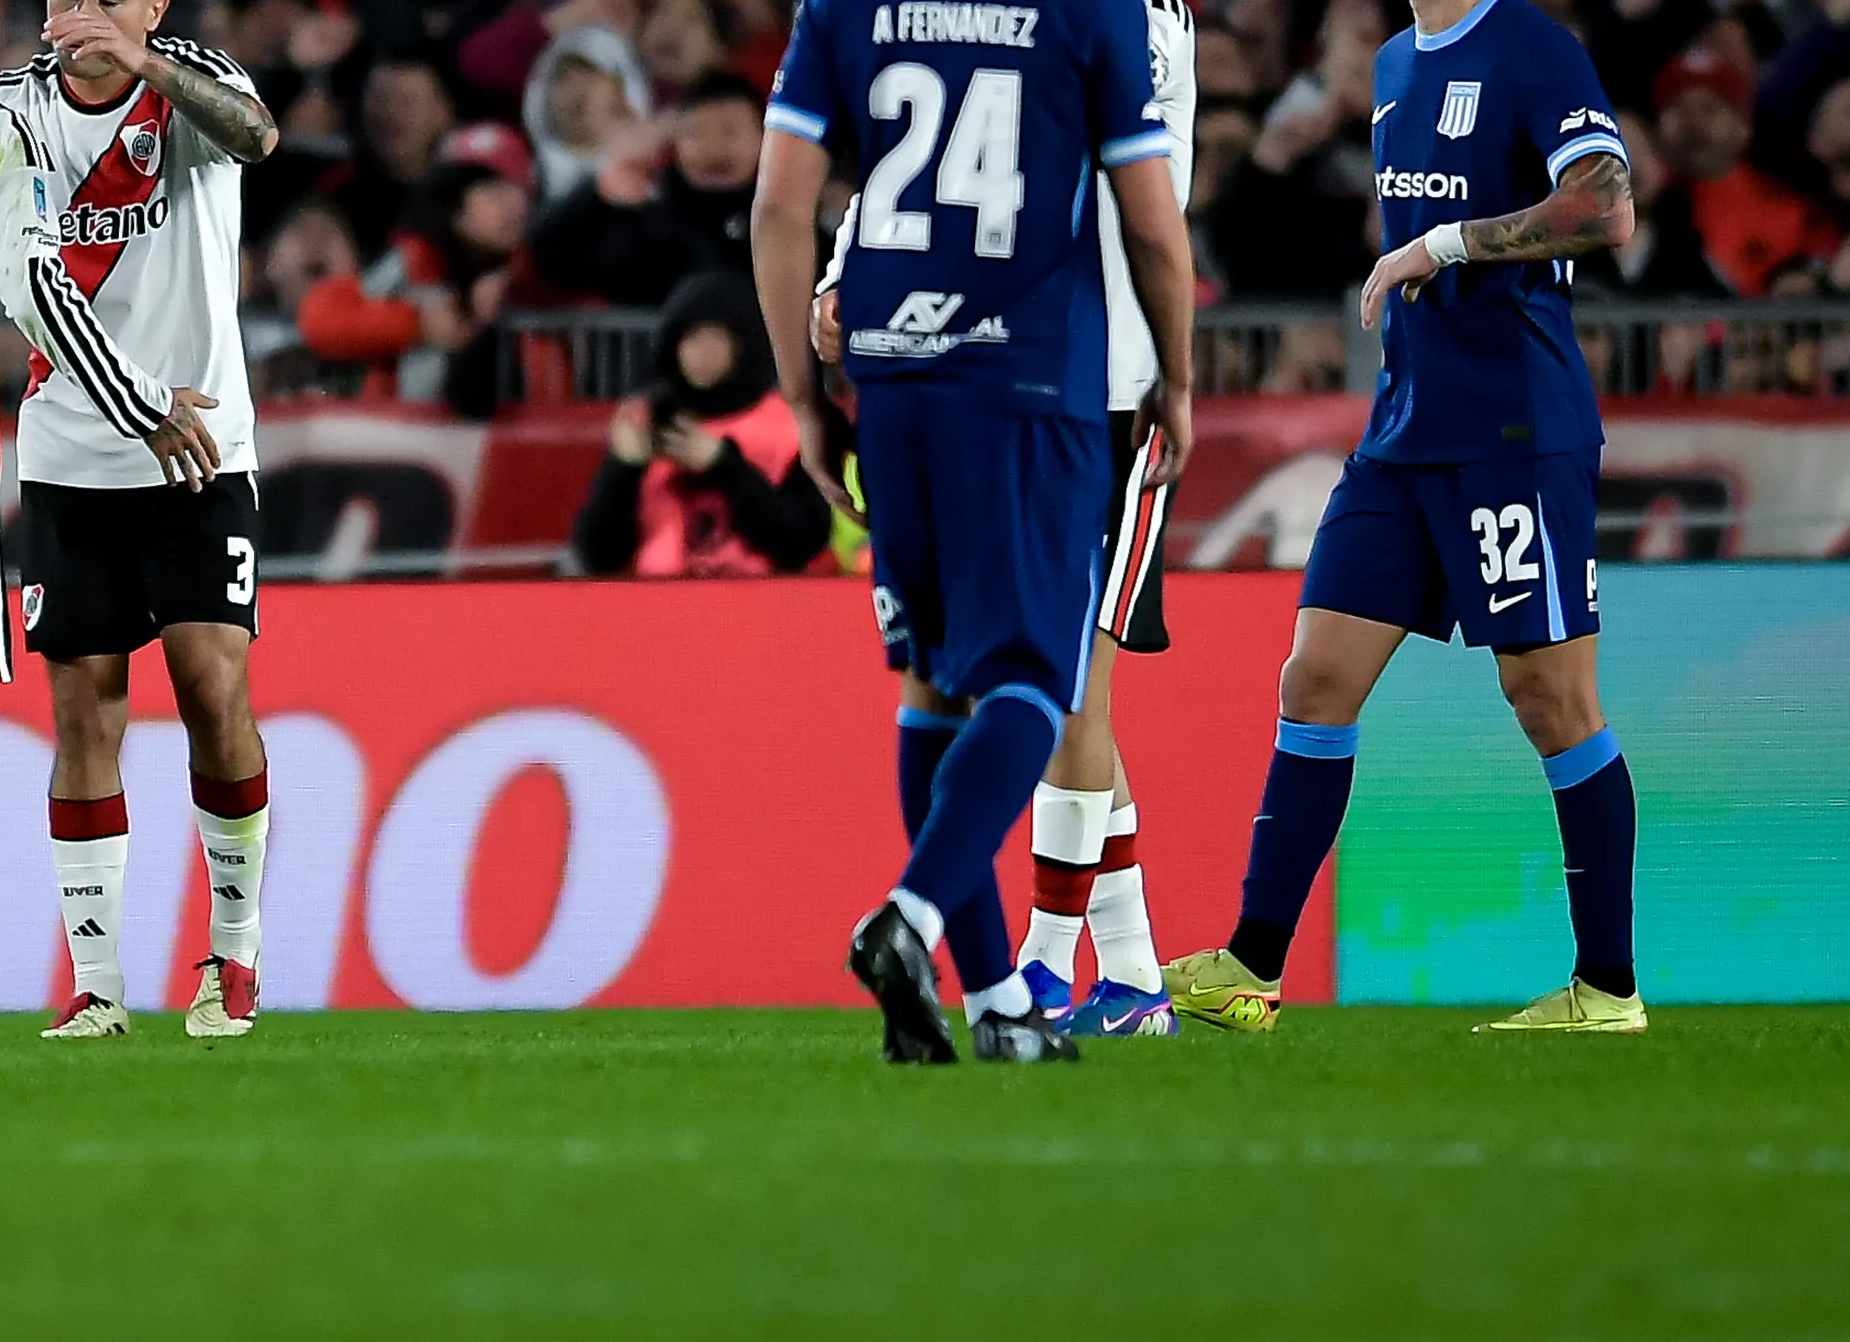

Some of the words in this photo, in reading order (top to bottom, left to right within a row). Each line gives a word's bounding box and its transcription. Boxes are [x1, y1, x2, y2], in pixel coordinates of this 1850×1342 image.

[872, 4, 895, 45] A
[897, 0, 1040, 48] FERNANDEZ
[857, 60, 1026, 259] 24
[226, 535, 255, 607] 3
[1470, 503, 1540, 585] 32
